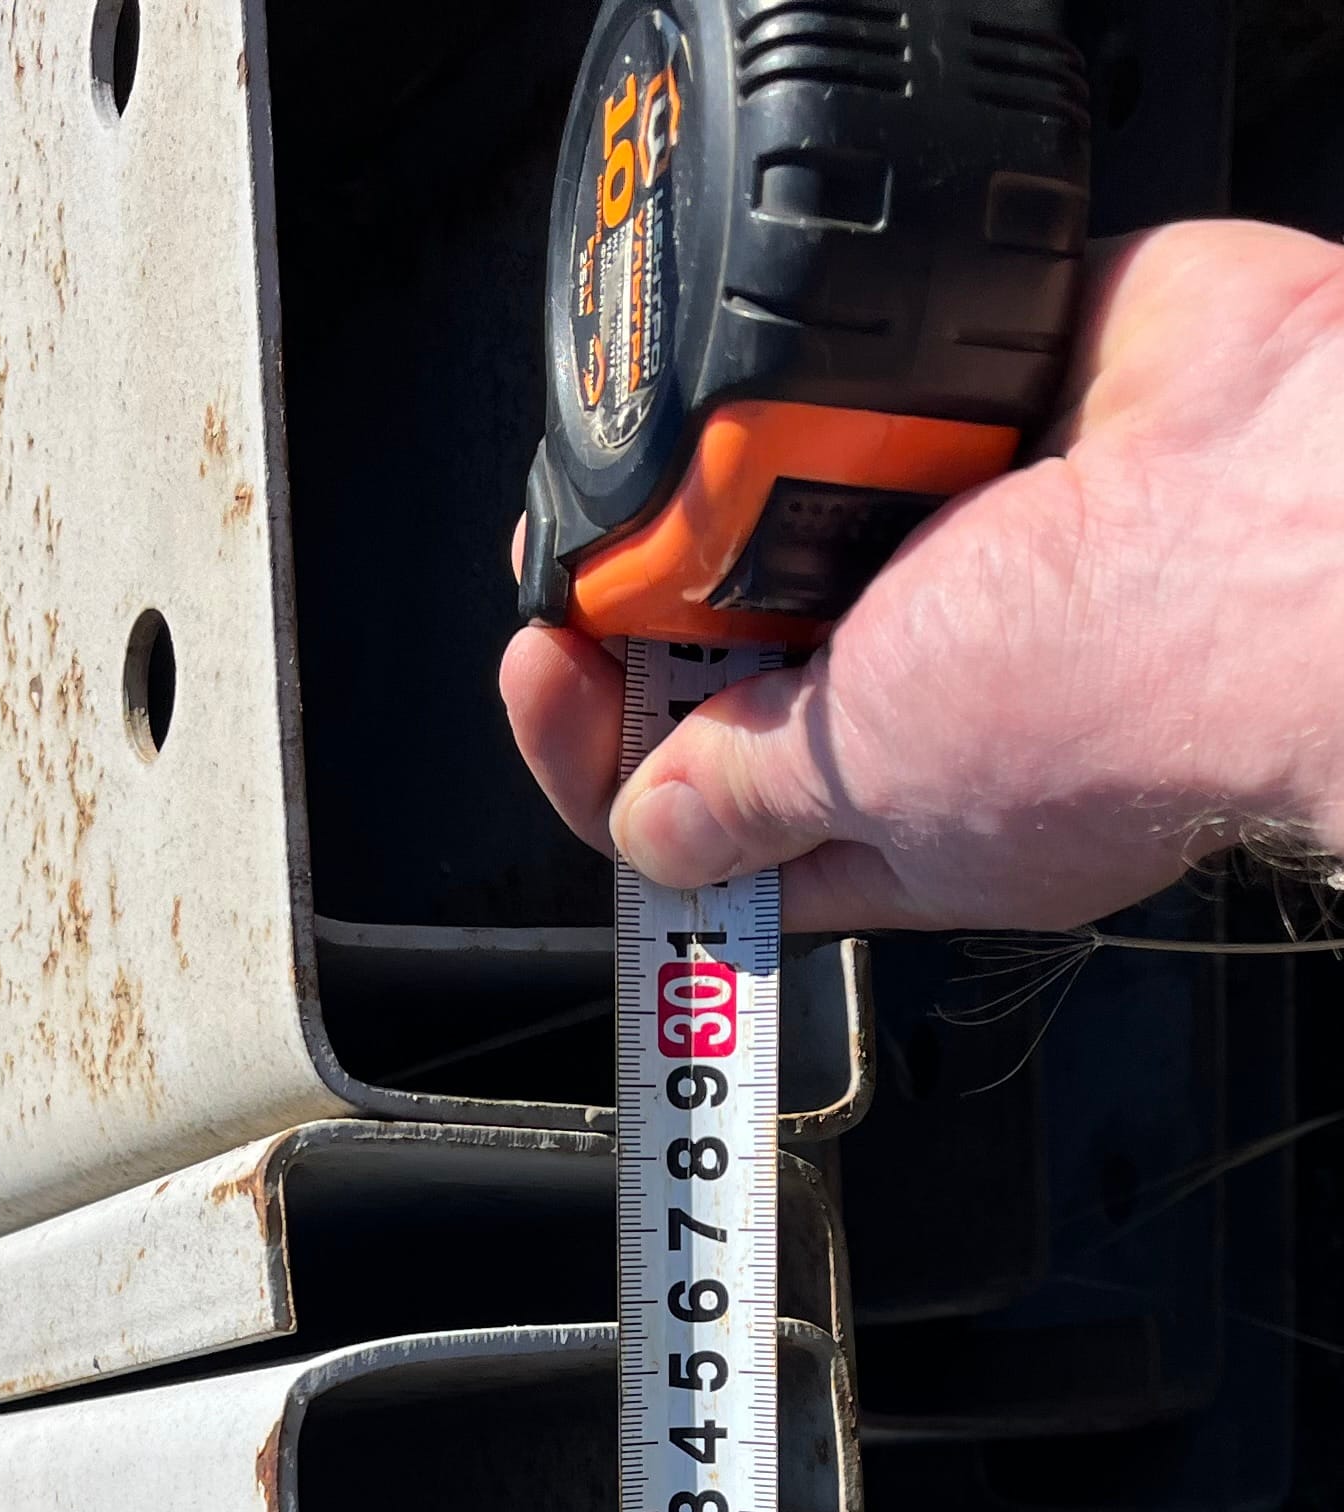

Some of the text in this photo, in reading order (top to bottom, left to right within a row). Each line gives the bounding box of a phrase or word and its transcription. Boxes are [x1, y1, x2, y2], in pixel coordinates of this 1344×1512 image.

[603, 72, 638, 229] 10
[630, 207, 645, 392] УЛЬТРА
[643, 196, 655, 381] ИНСТРУМЕНТ
[651, 188, 665, 377] ЦЕНТРО
[666, 930, 728, 958] 1
[663, 974, 733, 1046] 30
[665, 1063, 729, 1111] 9
[666, 1135, 730, 1182] 8
[668, 1206, 728, 1252] 7
[668, 1277, 730, 1323] 6
[668, 1352, 729, 1393] 5
[668, 1419, 728, 1464] 4
